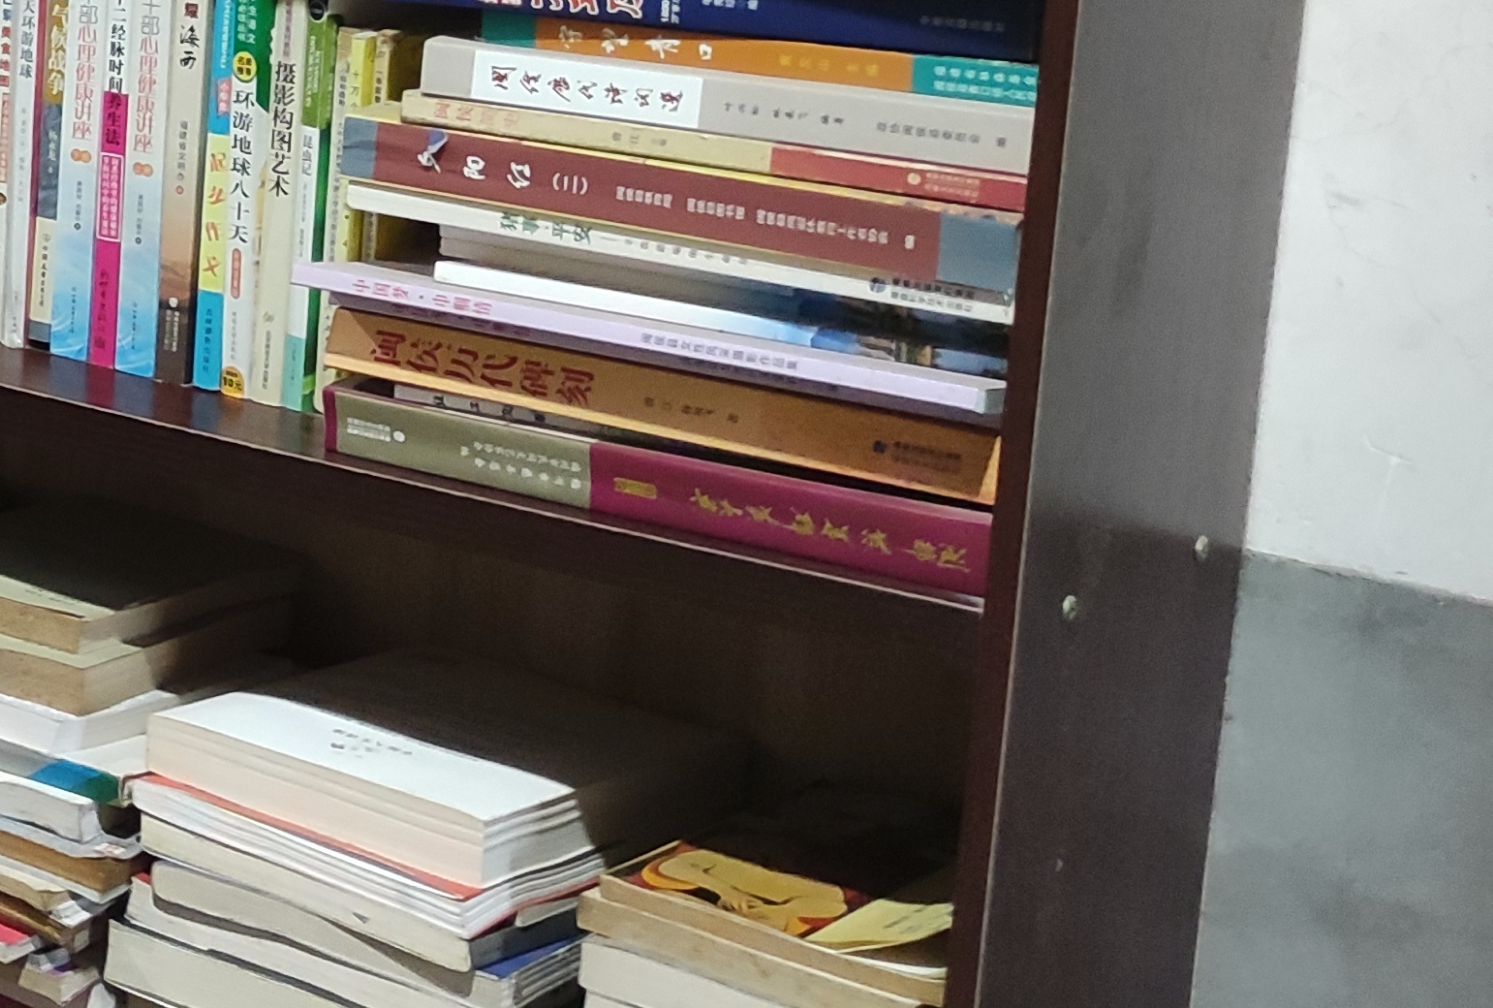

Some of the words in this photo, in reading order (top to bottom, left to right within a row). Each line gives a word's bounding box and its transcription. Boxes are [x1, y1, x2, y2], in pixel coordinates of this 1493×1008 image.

[229, 90, 257, 246] 环游地球八十天
[266, 61, 296, 199] 摄影构图艺术
[370, 328, 595, 408] 闽侯历代碑刻
